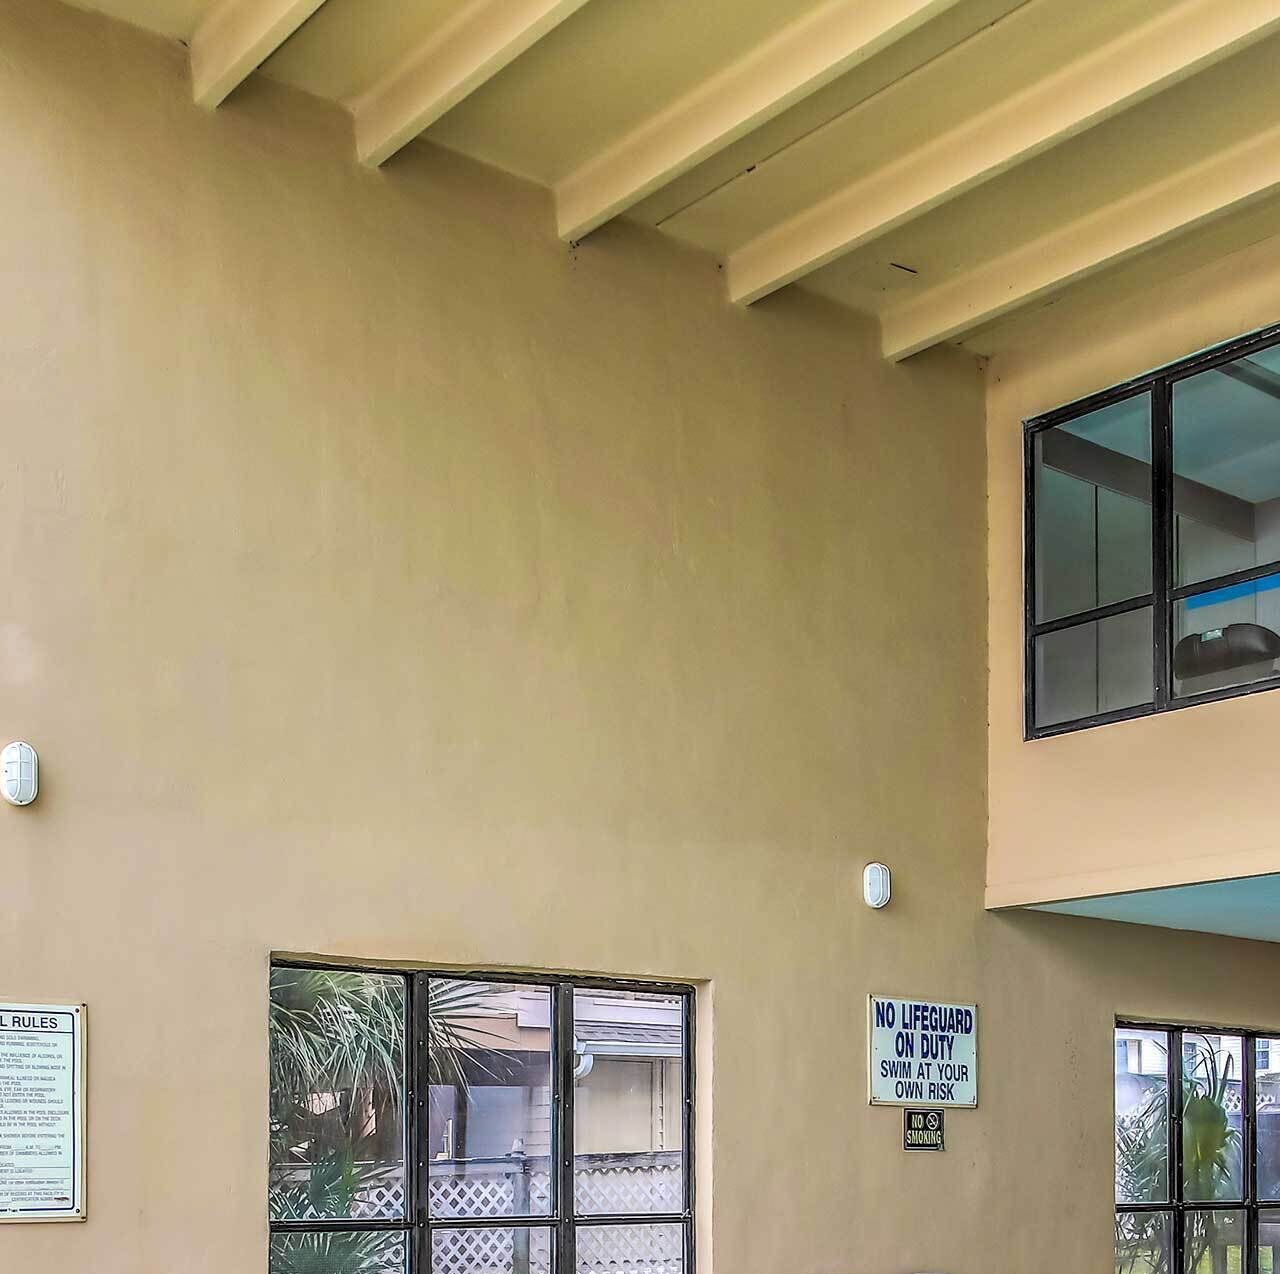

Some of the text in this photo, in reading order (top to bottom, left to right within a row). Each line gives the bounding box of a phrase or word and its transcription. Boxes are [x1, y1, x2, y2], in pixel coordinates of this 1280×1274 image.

[12, 1016, 58, 1029] RULES
[876, 1002, 973, 1034] NO LIFEGUARD
[895, 1031, 955, 1060] ON DUTY
[881, 1060, 968, 1081] SWIM AT YOUR
[895, 1081, 923, 1099] OWN
[928, 1083, 955, 1100] RISK
[911, 1114, 923, 1128] NO
[906, 1130, 941, 1144] SMOKING
